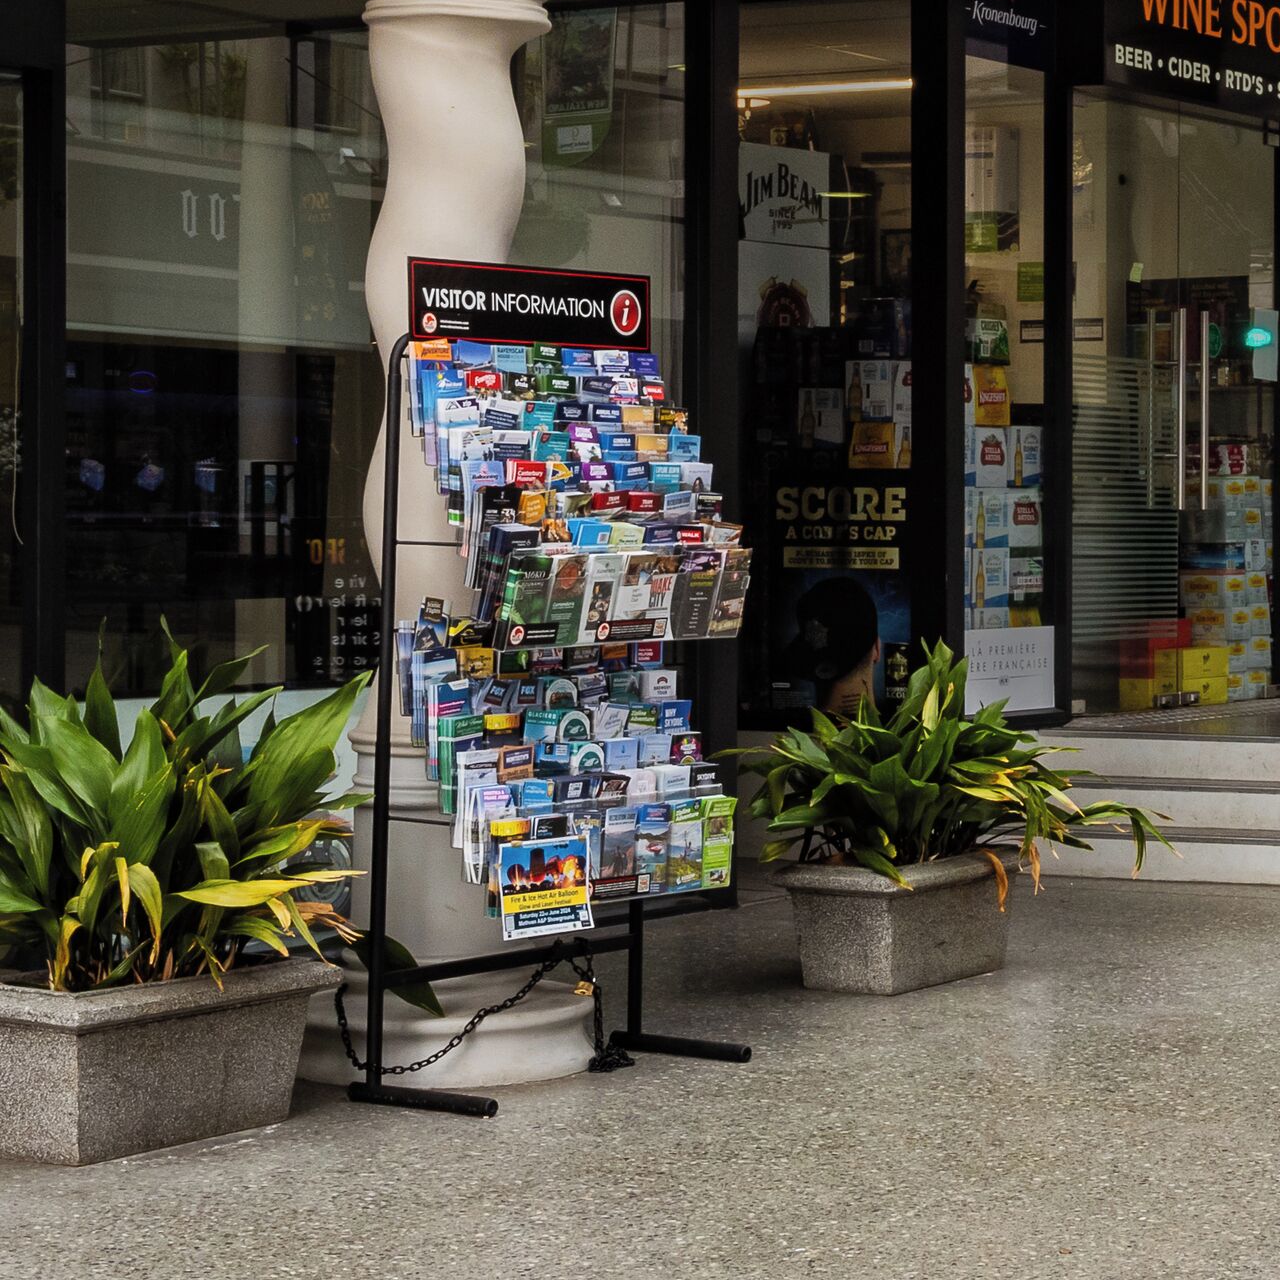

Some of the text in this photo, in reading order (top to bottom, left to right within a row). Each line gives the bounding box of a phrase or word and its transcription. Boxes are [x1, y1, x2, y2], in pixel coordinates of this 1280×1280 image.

[972, 0, 1039, 37] Kronenbourg
[1115, 43, 1153, 71] BEER
[1168, 55, 1211, 84] CIDER
[1224, 68, 1264, 96] RTD'S
[743, 162, 825, 224] JIM BEAM
[421, 286, 605, 319] VISITOR INFORMATION
[775, 486, 907, 521] SCORE
[784, 525, 797, 540] A
[863, 525, 897, 541] CAP
[993, 657, 1048, 671] FRANÇAISE
[489, 685, 505, 697] FOX
[520, 685, 535, 695] FOX
[511, 895, 521, 903] Fire
[537, 892, 548, 900] Hot
[549, 891, 557, 899] Air
[558, 889, 579, 897] Balloon
[518, 903, 531, 911] Glow
[532, 901, 541, 909] and
[519, 911, 539, 919] Saturday
[549, 909, 560, 917] June
